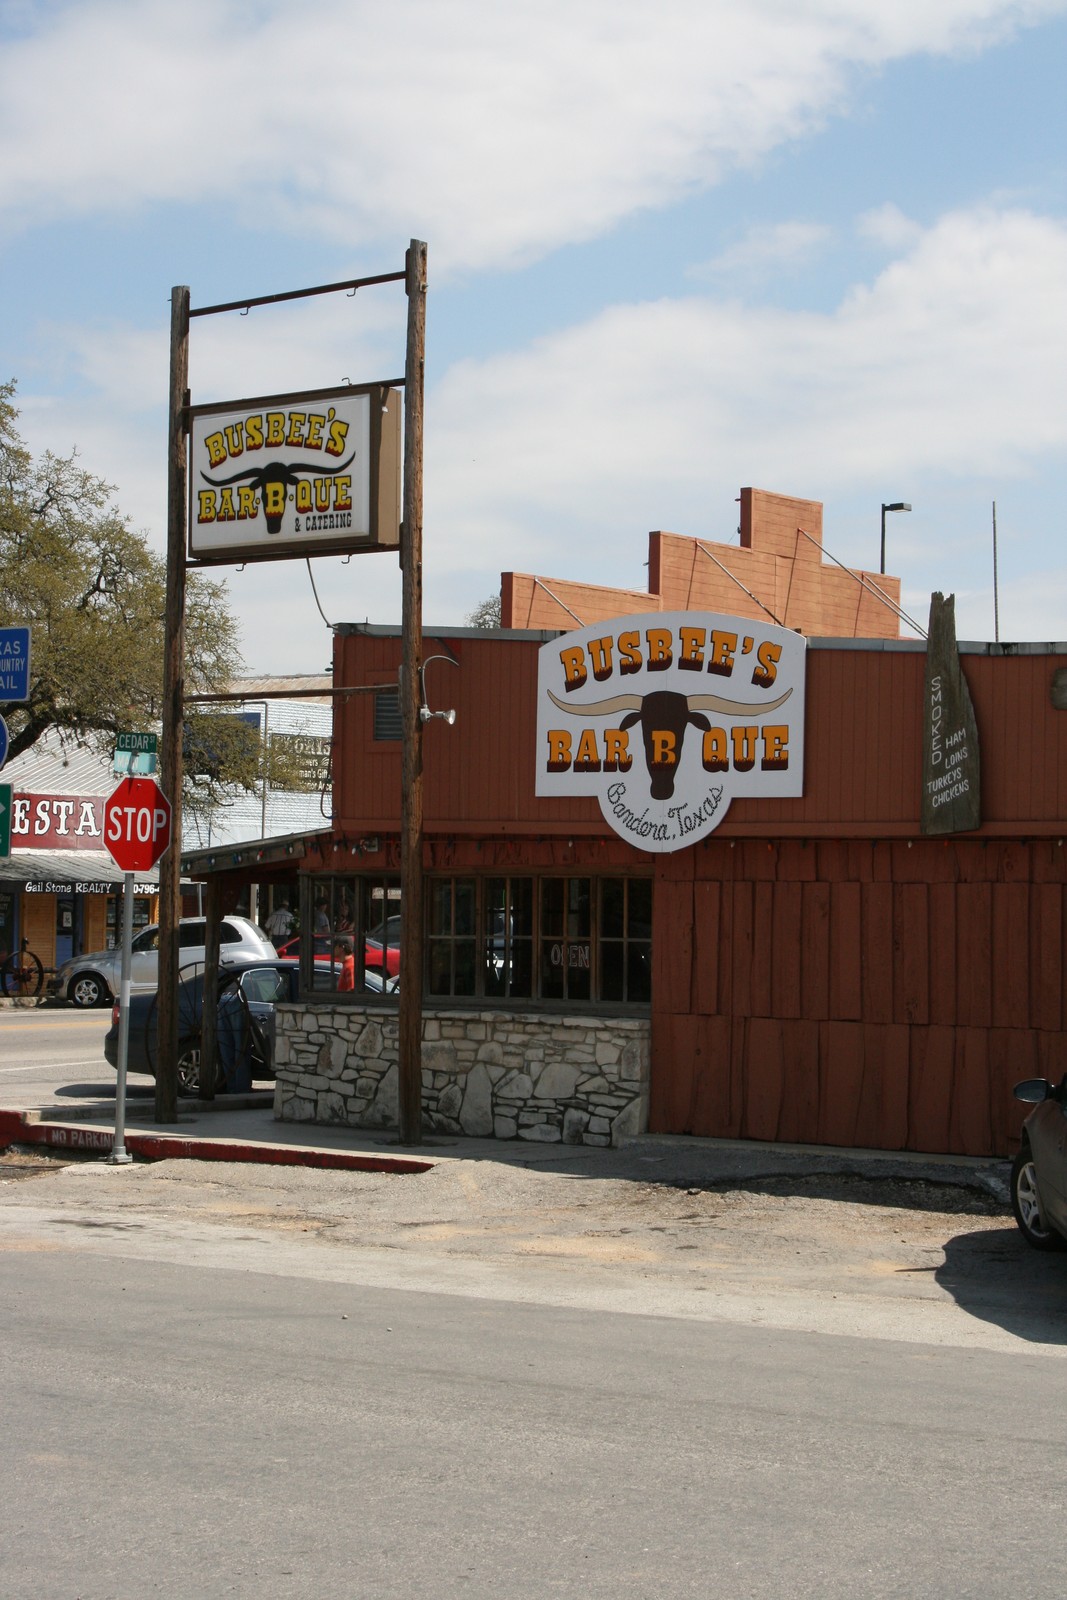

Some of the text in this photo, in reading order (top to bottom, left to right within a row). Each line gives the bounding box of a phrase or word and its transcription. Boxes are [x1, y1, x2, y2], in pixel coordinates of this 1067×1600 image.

[204, 407, 350, 469] BUSBEE'S
[294, 513, 352, 532] & CATERING
[0, 657, 25, 672] UNTRY
[559, 626, 782, 693] BUSBEE'S
[931, 676, 942, 765] SMOKED
[119, 734, 156, 750] CEDAR ST
[546, 725, 789, 773] BAR B QUE
[945, 728, 967, 749] HAM
[945, 747, 969, 769] LOINS
[927, 767, 962, 794] TURKEYS
[932, 779, 970, 808] CHICKENS
[11, 799, 102, 837] ESTA
[107, 806, 167, 842] STOP
[667, 784, 725, 837] Texas
[25, 881, 43, 893] Gail
[45, 882, 72, 893] Stone
[75, 882, 112, 894] REALTY
[52, 1129, 67, 1145] NO
